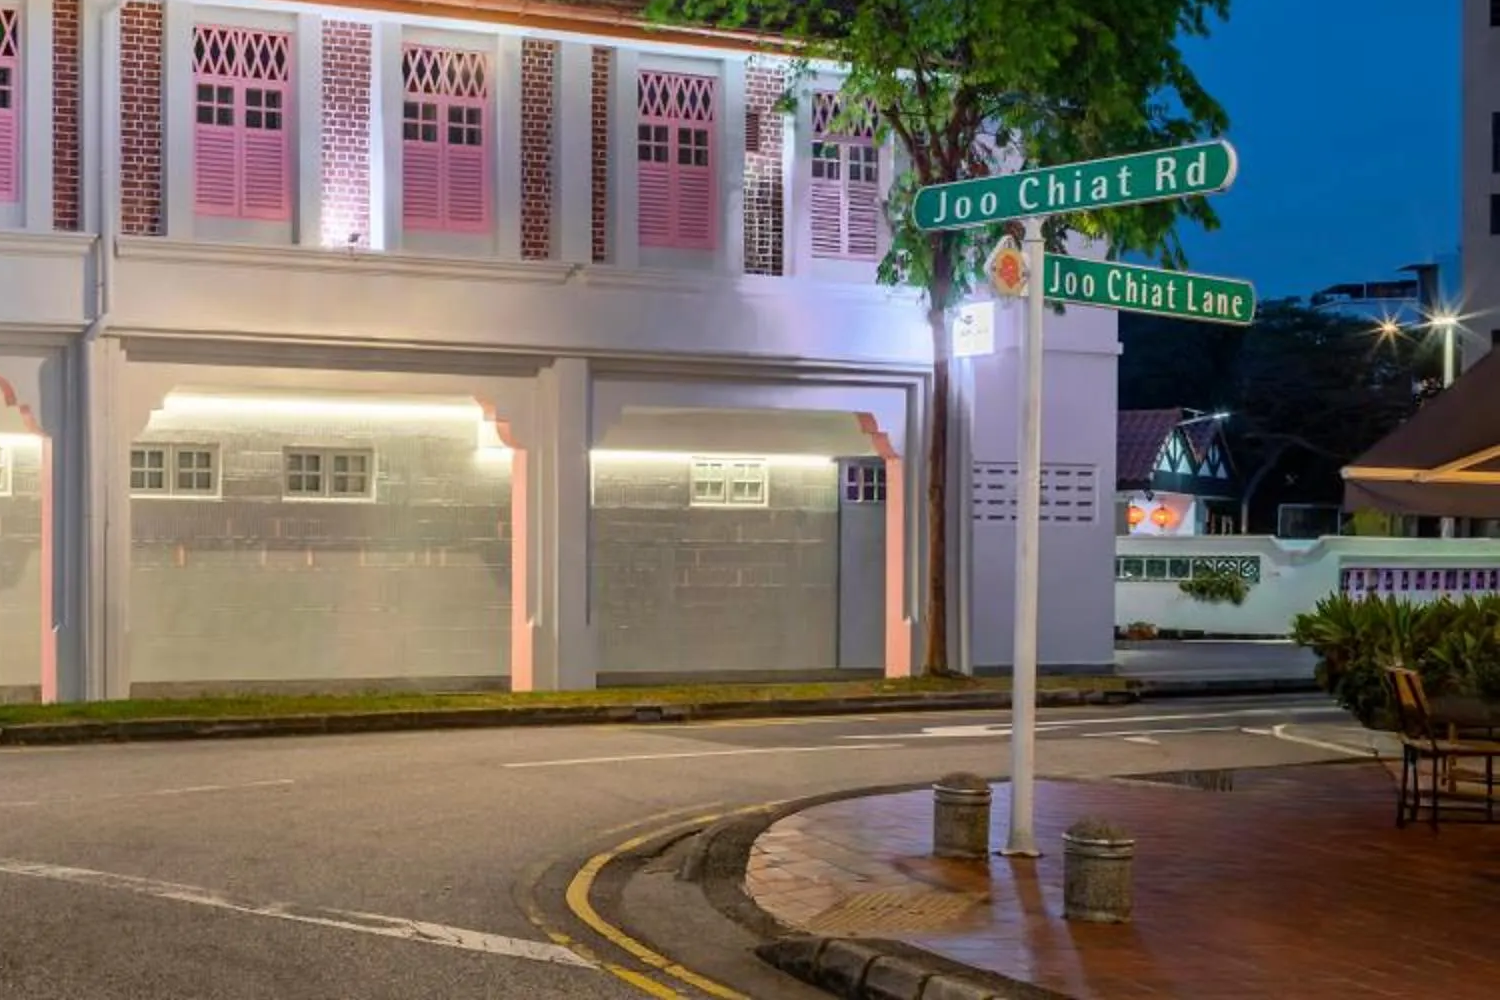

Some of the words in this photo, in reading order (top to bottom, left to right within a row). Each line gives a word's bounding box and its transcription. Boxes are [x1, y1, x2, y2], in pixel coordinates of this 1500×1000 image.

[933, 191, 998, 223] Joo
[1019, 165, 1132, 210] Chiat
[1155, 151, 1206, 191] Rd
[1049, 262, 1095, 296] Joo
[1107, 268, 1177, 309] Chiat
[1187, 284, 1243, 318] Lane
